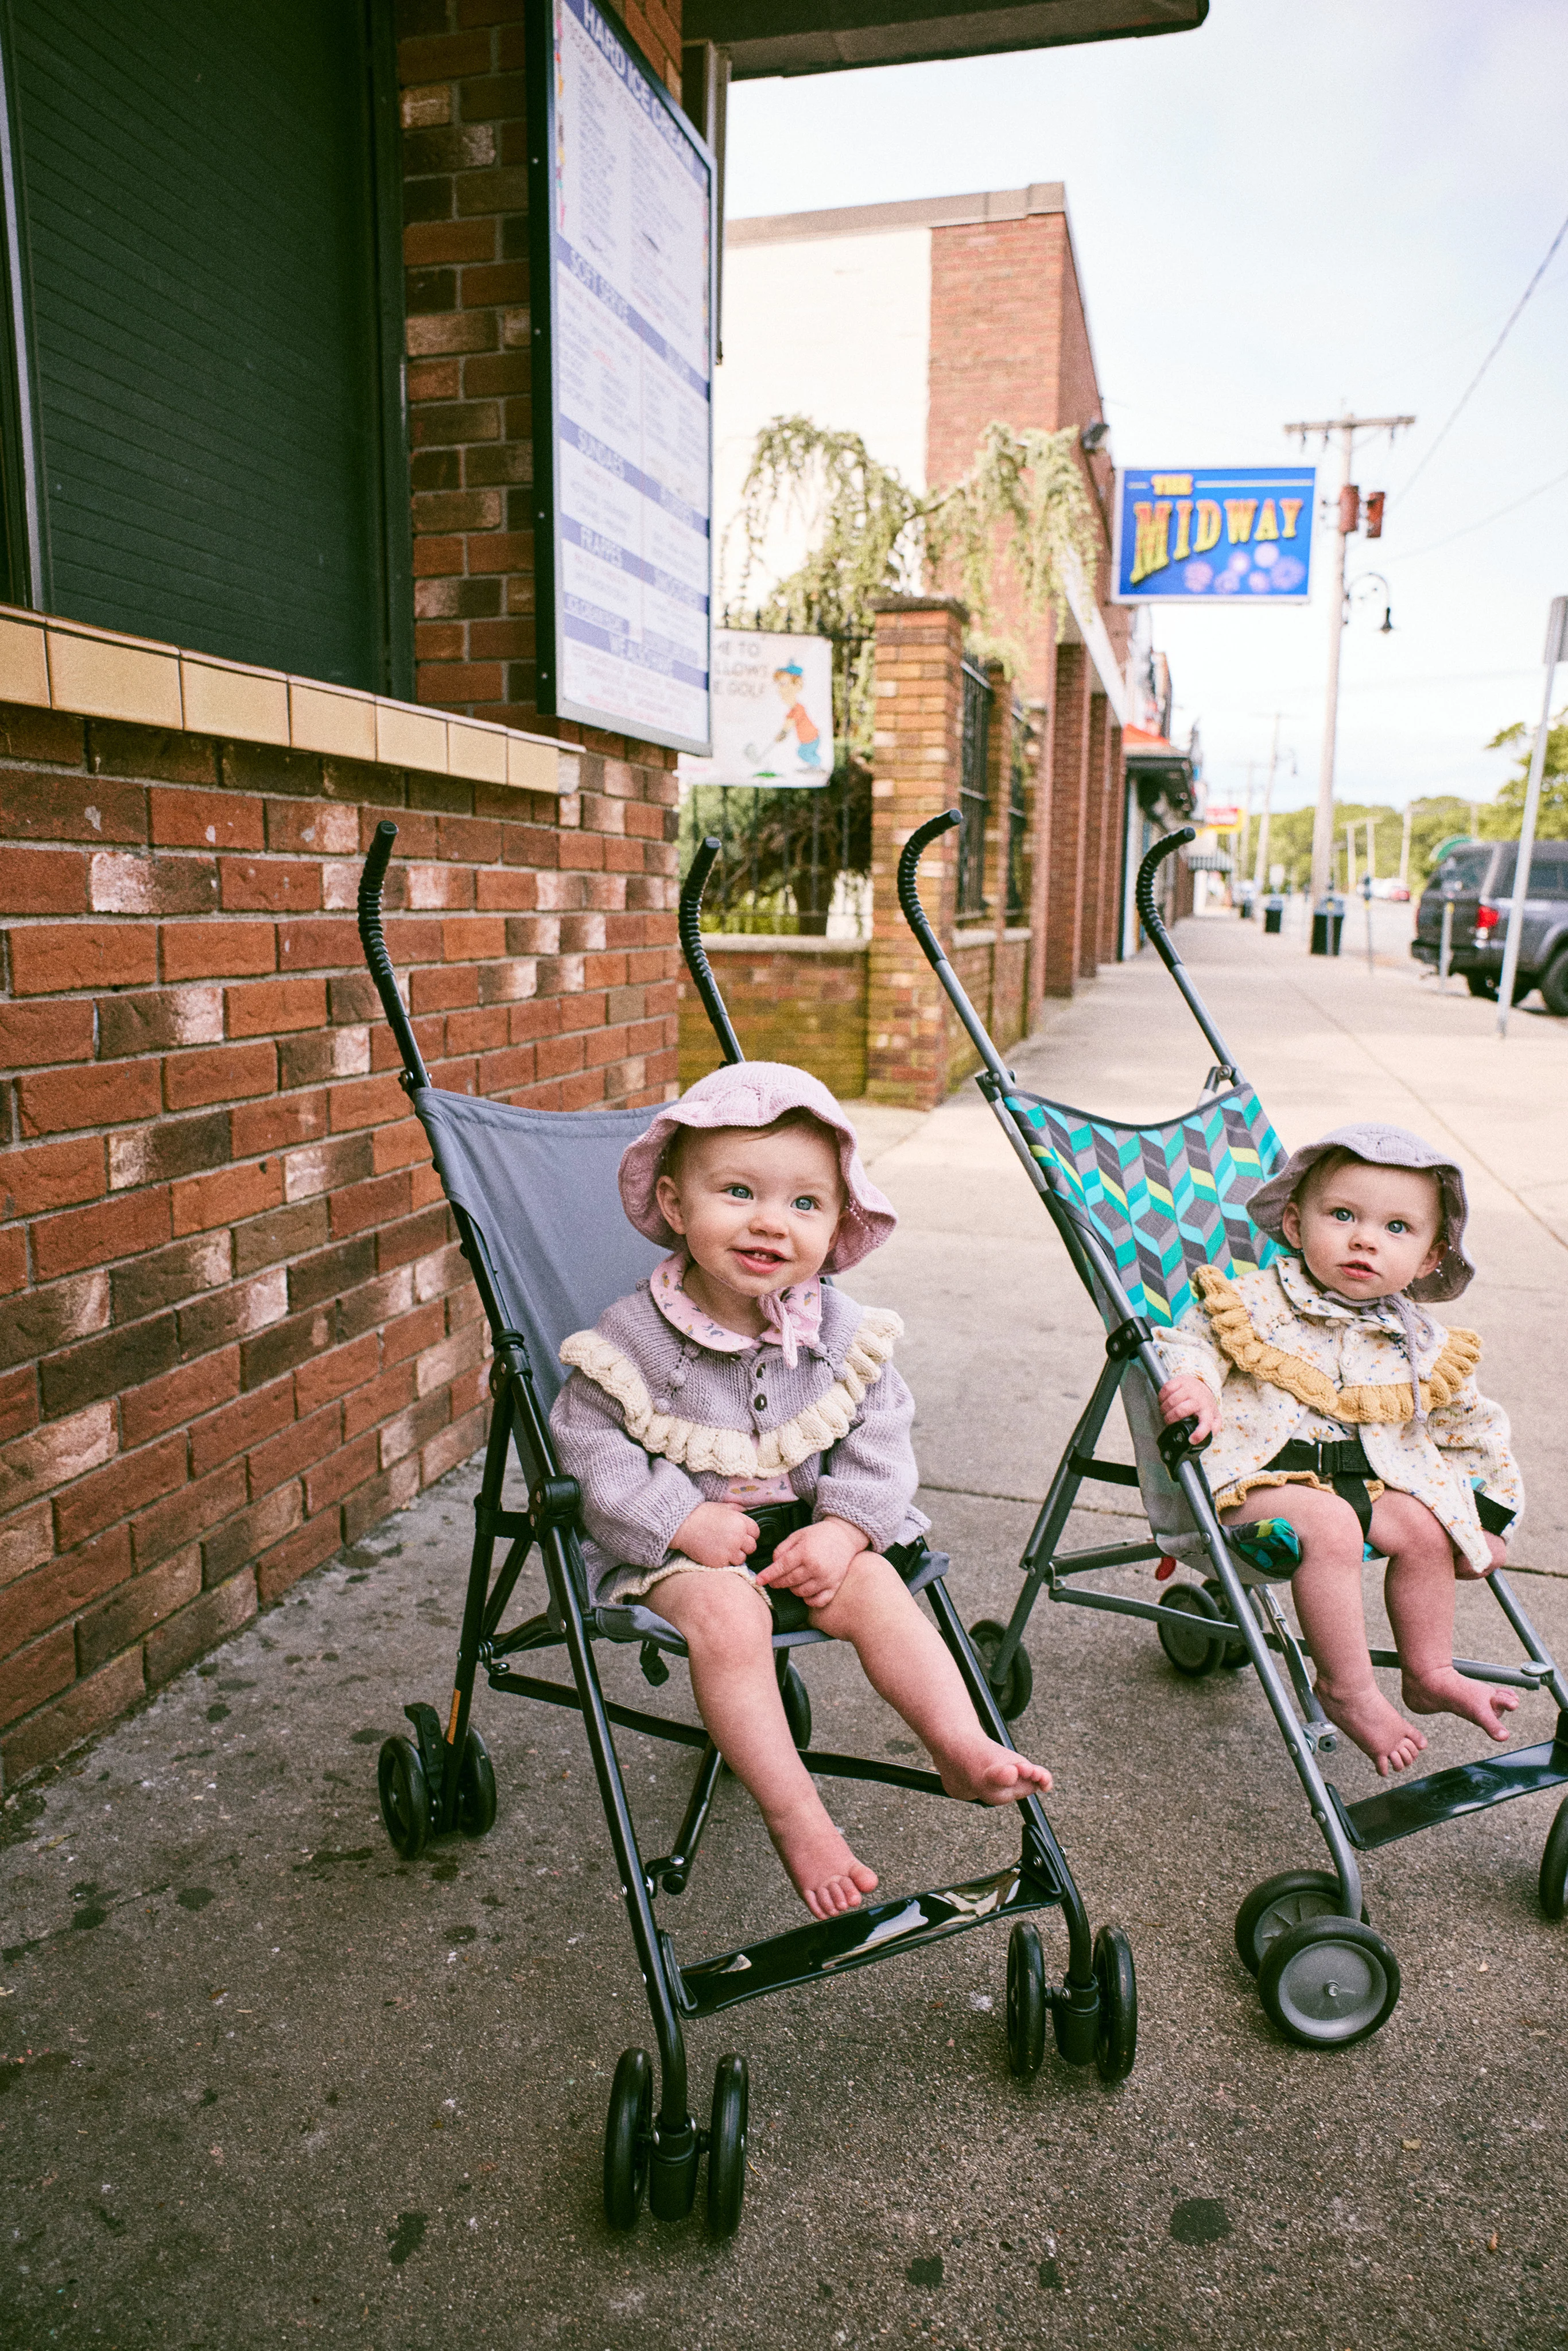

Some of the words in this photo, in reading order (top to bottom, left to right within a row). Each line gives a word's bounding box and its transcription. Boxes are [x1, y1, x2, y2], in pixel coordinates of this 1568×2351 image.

[584, 0, 626, 77] HARD
[627, 60, 652, 114] ICE
[1151, 474, 1193, 496] THE
[1130, 498, 1304, 584] MIDWAY
[738, 641, 761, 658] TO
